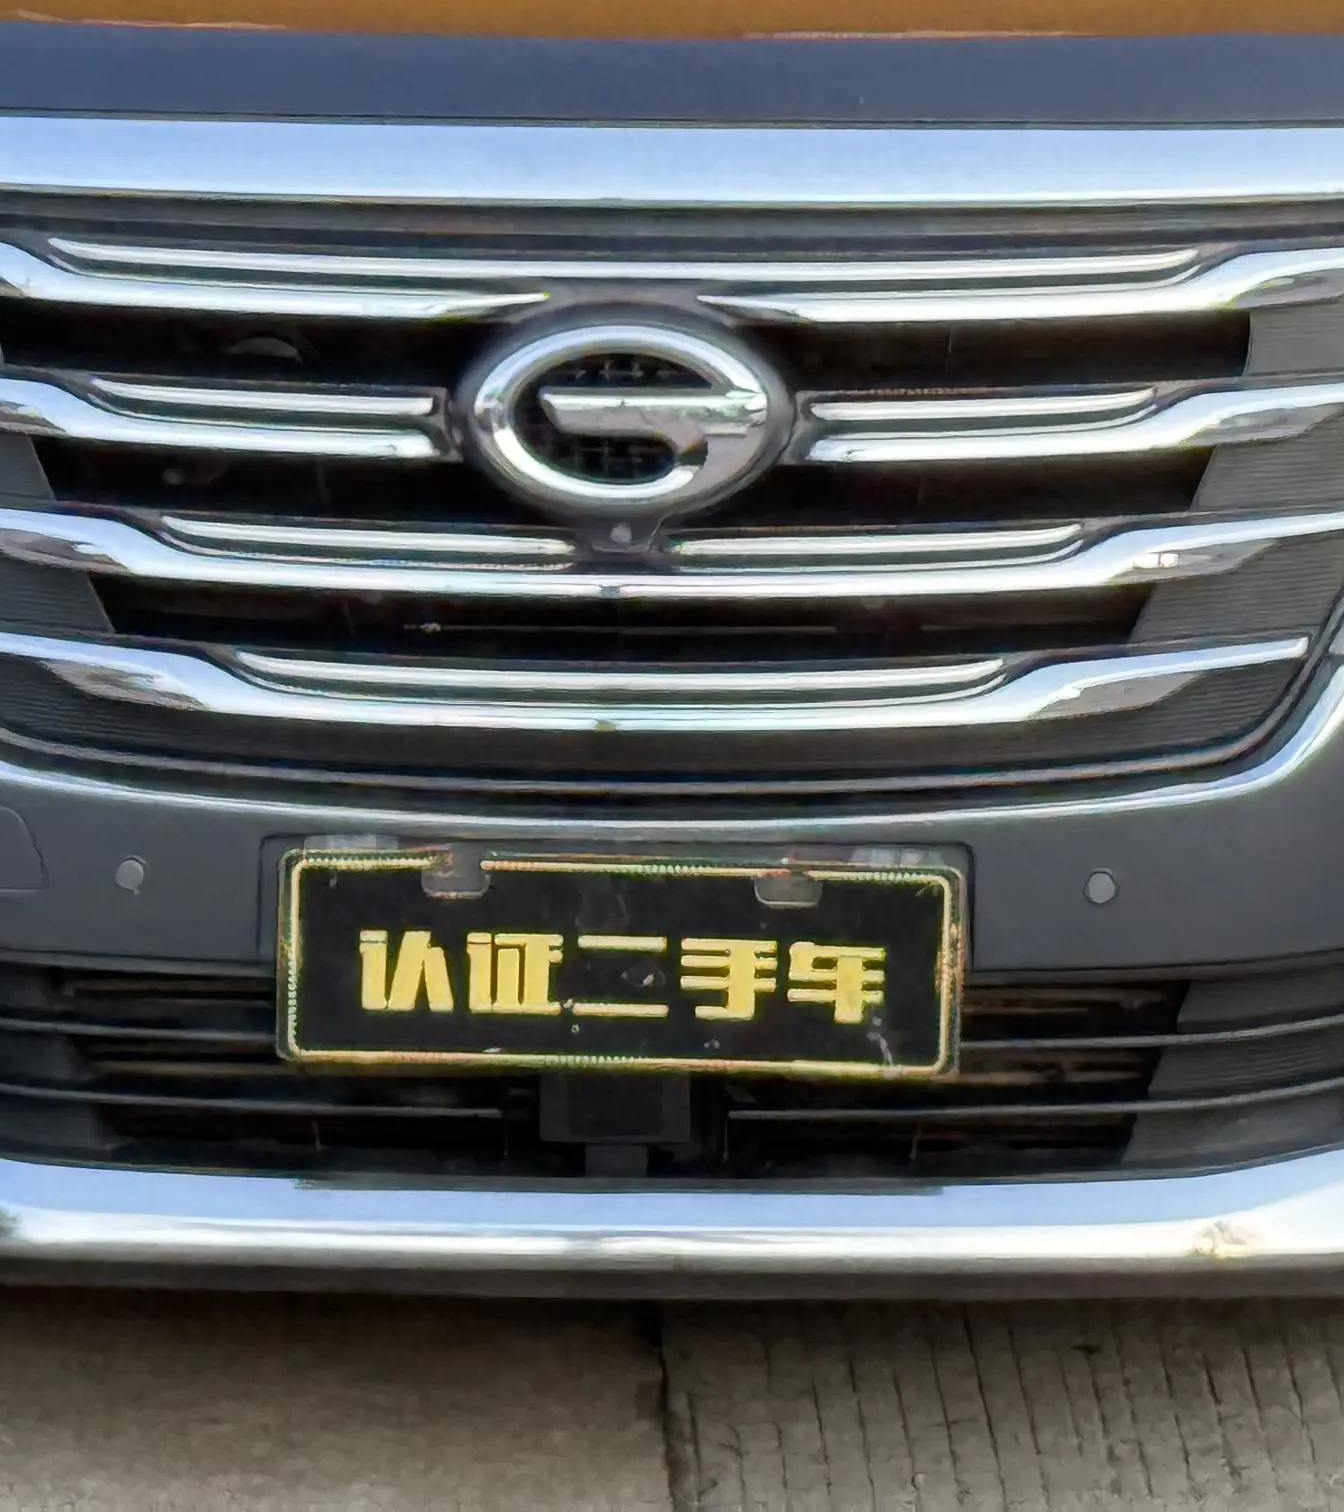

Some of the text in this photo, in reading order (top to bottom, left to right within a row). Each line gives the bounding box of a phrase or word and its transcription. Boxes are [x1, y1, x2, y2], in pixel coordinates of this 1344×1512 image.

[359, 929, 887, 1025] 认证二手车
